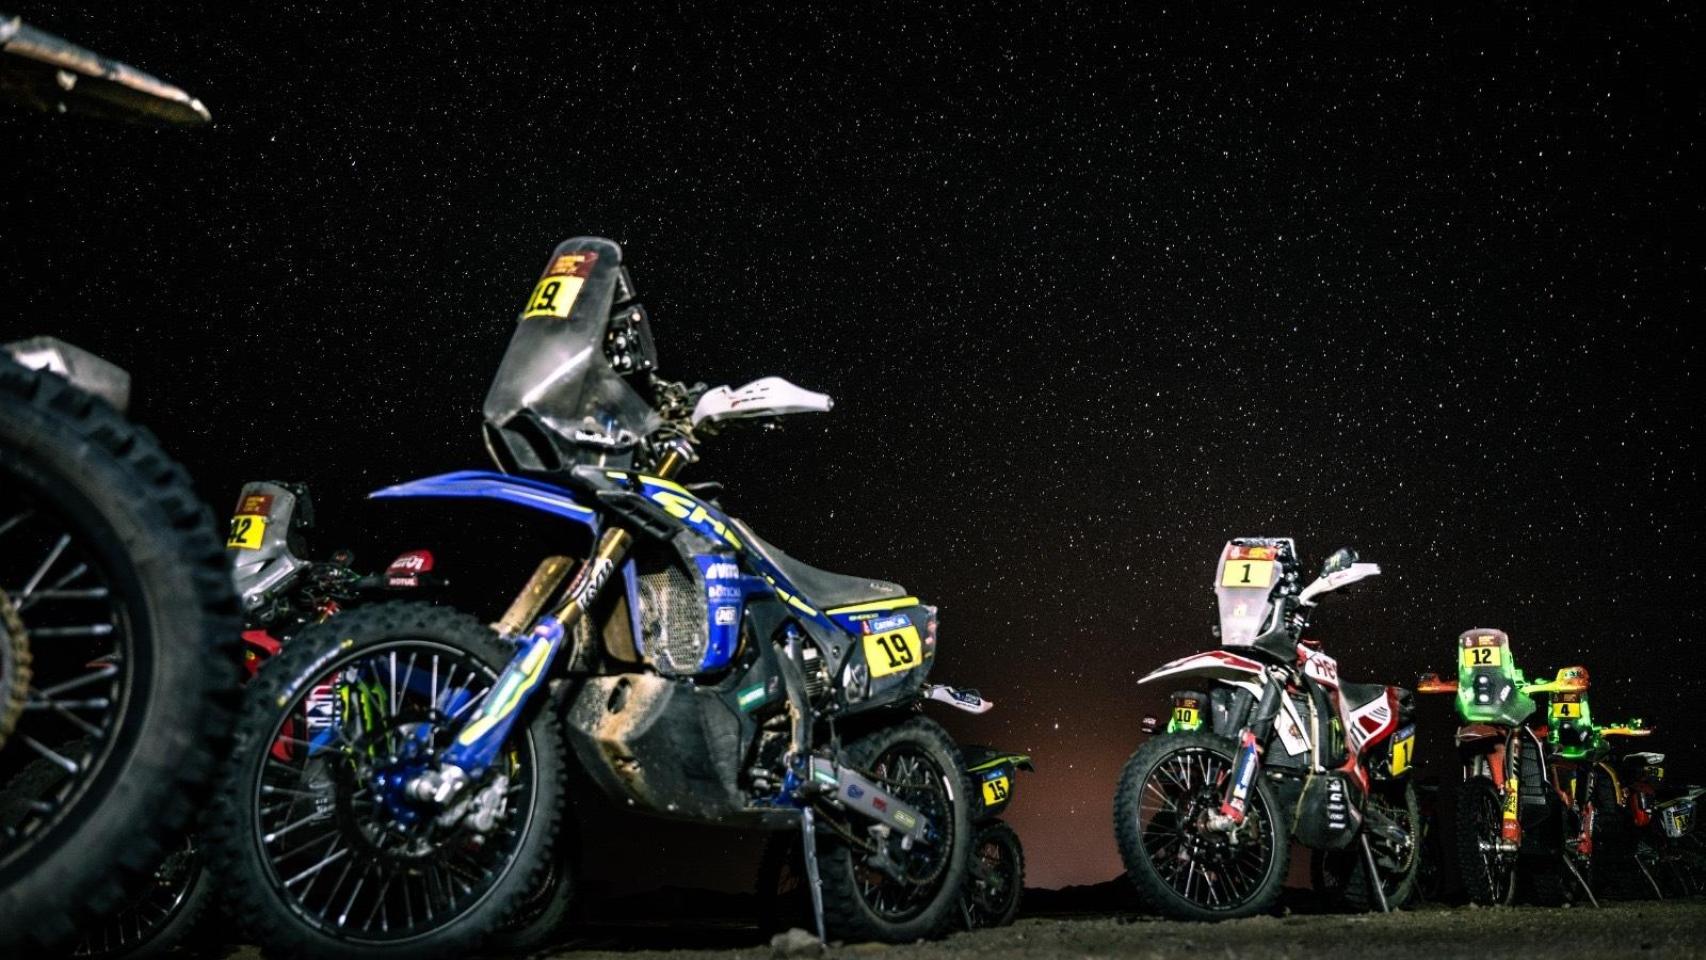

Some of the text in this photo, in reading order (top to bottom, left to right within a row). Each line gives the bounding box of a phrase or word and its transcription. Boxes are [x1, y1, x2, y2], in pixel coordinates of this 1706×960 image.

[1240, 563, 1251, 583] 1
[876, 633, 914, 668] 19
[1472, 648, 1493, 665] 12
[1177, 709, 1191, 722] 10
[1560, 704, 1570, 716] 4
[988, 780, 1007, 801] 15
